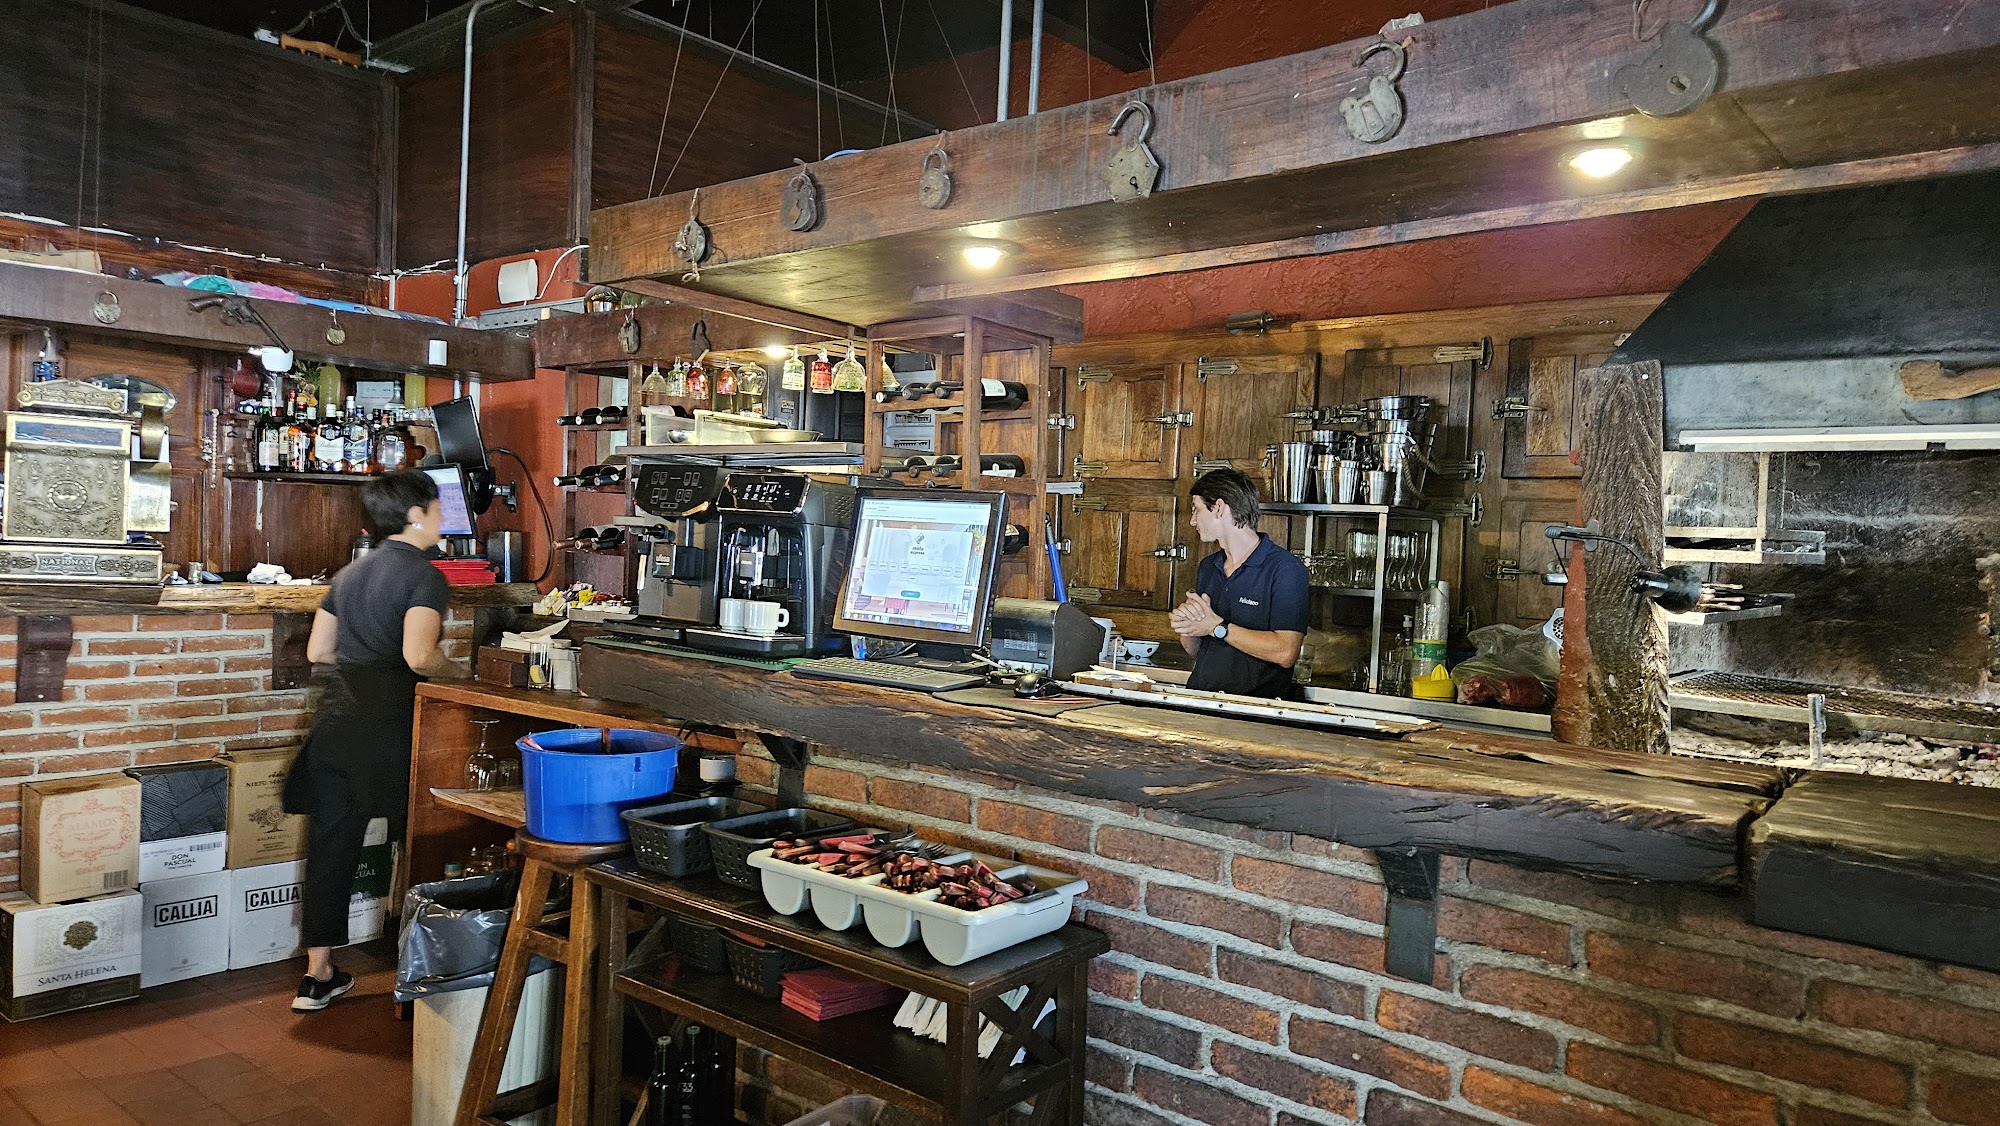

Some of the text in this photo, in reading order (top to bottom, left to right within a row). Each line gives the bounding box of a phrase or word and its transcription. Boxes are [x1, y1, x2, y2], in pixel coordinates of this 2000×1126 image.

[41, 558, 93, 566] NATIONAL
[245, 780, 267, 788] NIETO
[69, 817, 118, 832] ALAMOS
[164, 857, 196, 867] PASCUAL
[171, 853, 189, 861] DON
[250, 886, 301, 908] CALLIA
[159, 900, 213, 923] CALLIA
[37, 965, 117, 987] SANTA HELENA
[682, 1083, 694, 1091] 33
